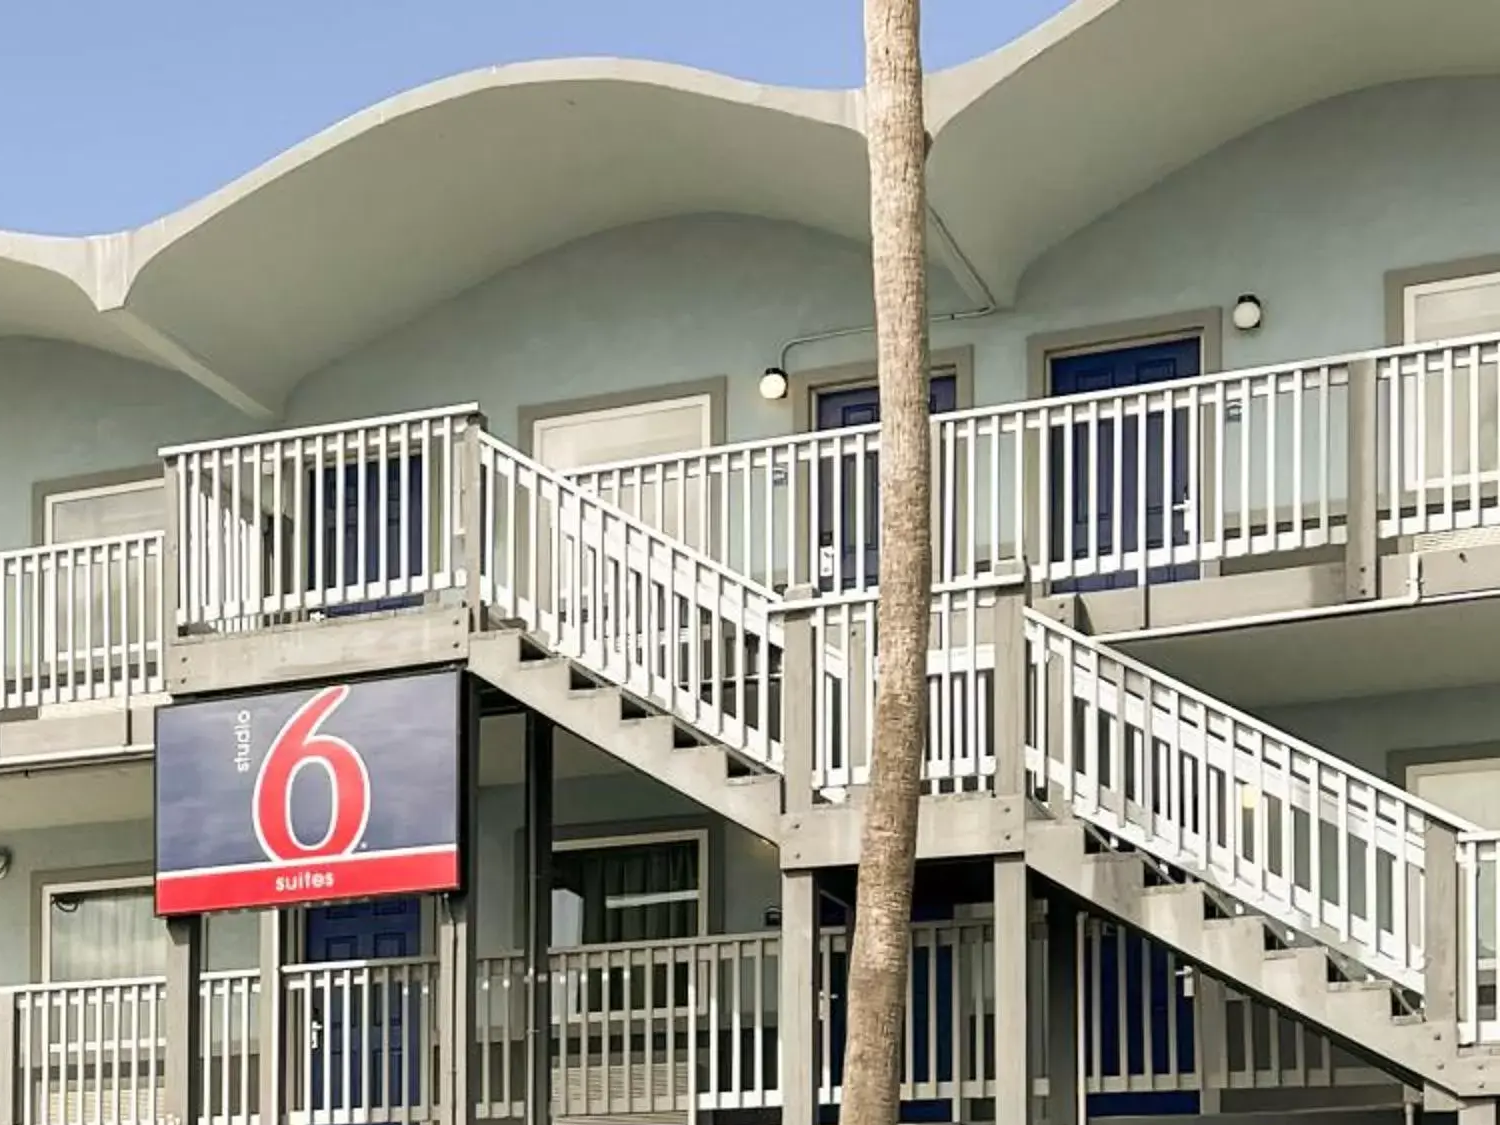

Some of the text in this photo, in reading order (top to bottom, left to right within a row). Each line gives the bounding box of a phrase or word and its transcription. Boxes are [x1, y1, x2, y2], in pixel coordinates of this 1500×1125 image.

[234, 709, 250, 772] studio
[252, 684, 371, 863] 6
[275, 870, 335, 892] suites
